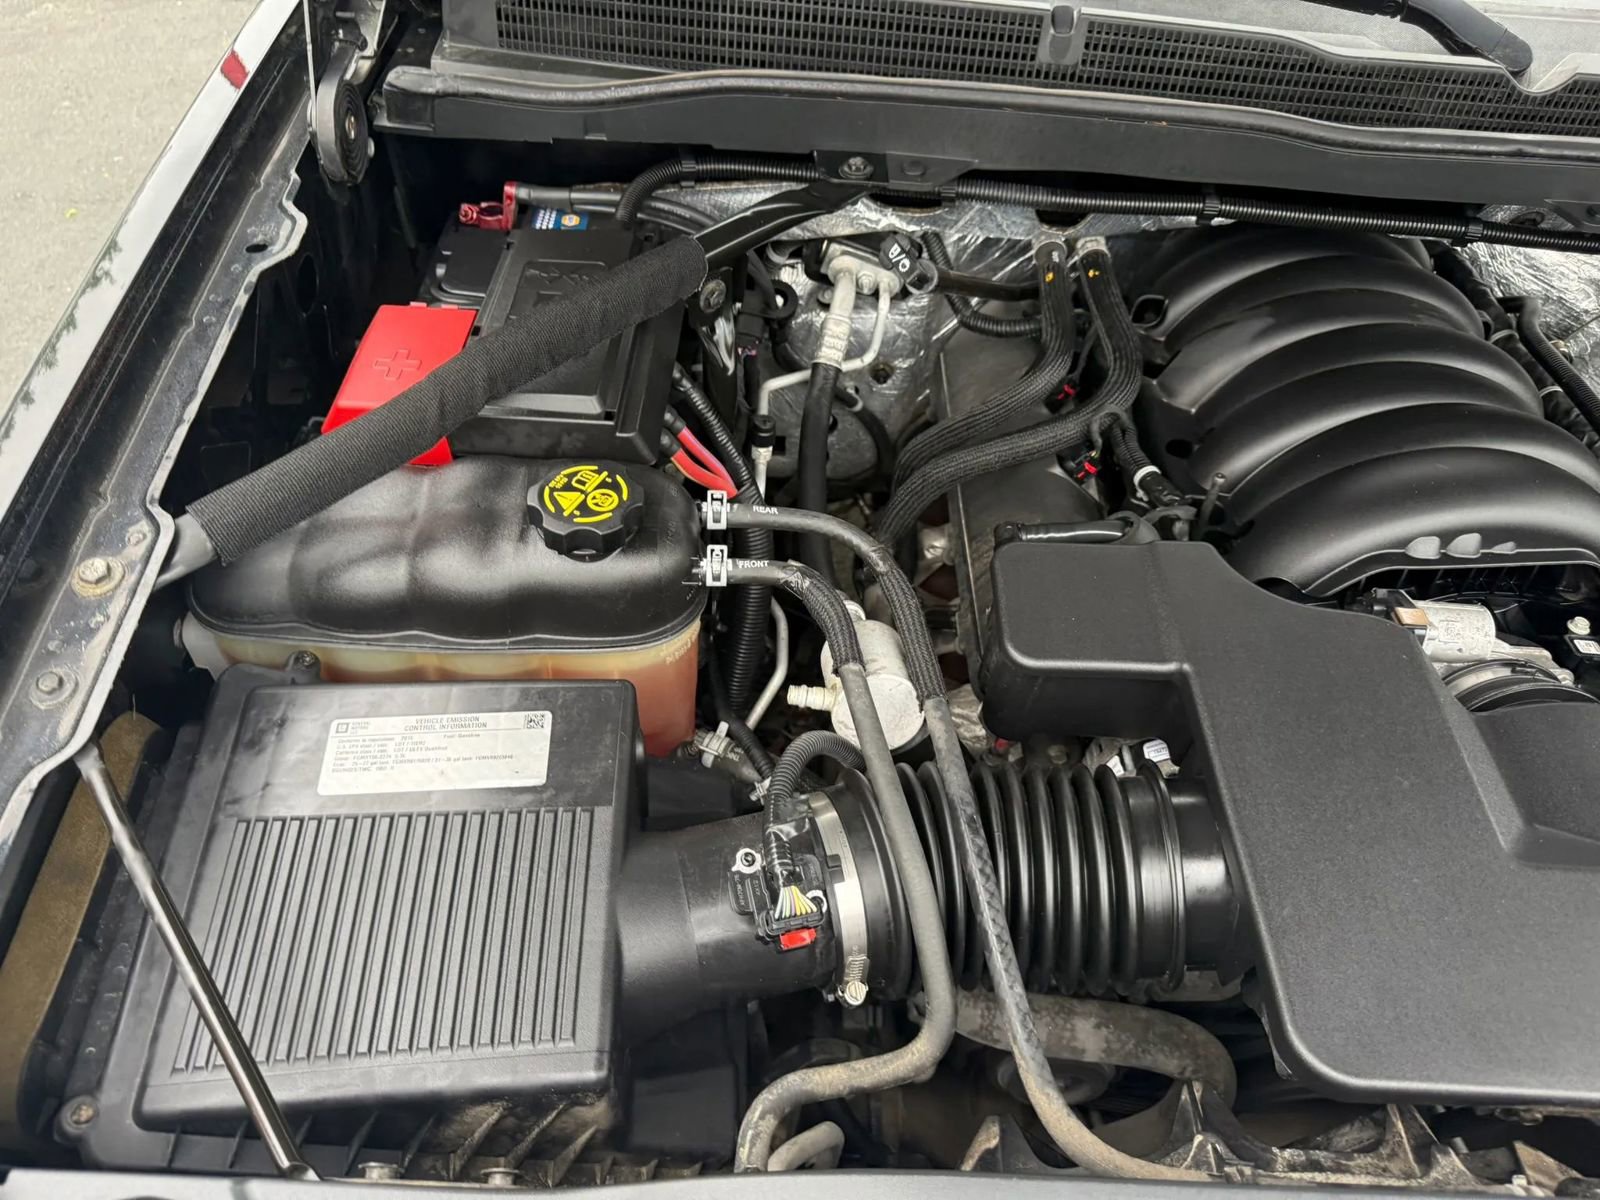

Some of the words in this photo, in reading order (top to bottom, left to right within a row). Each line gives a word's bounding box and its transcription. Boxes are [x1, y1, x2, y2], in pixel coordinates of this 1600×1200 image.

[753, 505, 778, 515] REAR
[738, 560, 769, 569] FRONT
[446, 716, 480, 724] EMISSION
[404, 724, 437, 732] CONTROL
[439, 722, 488, 730] INFORMATION
